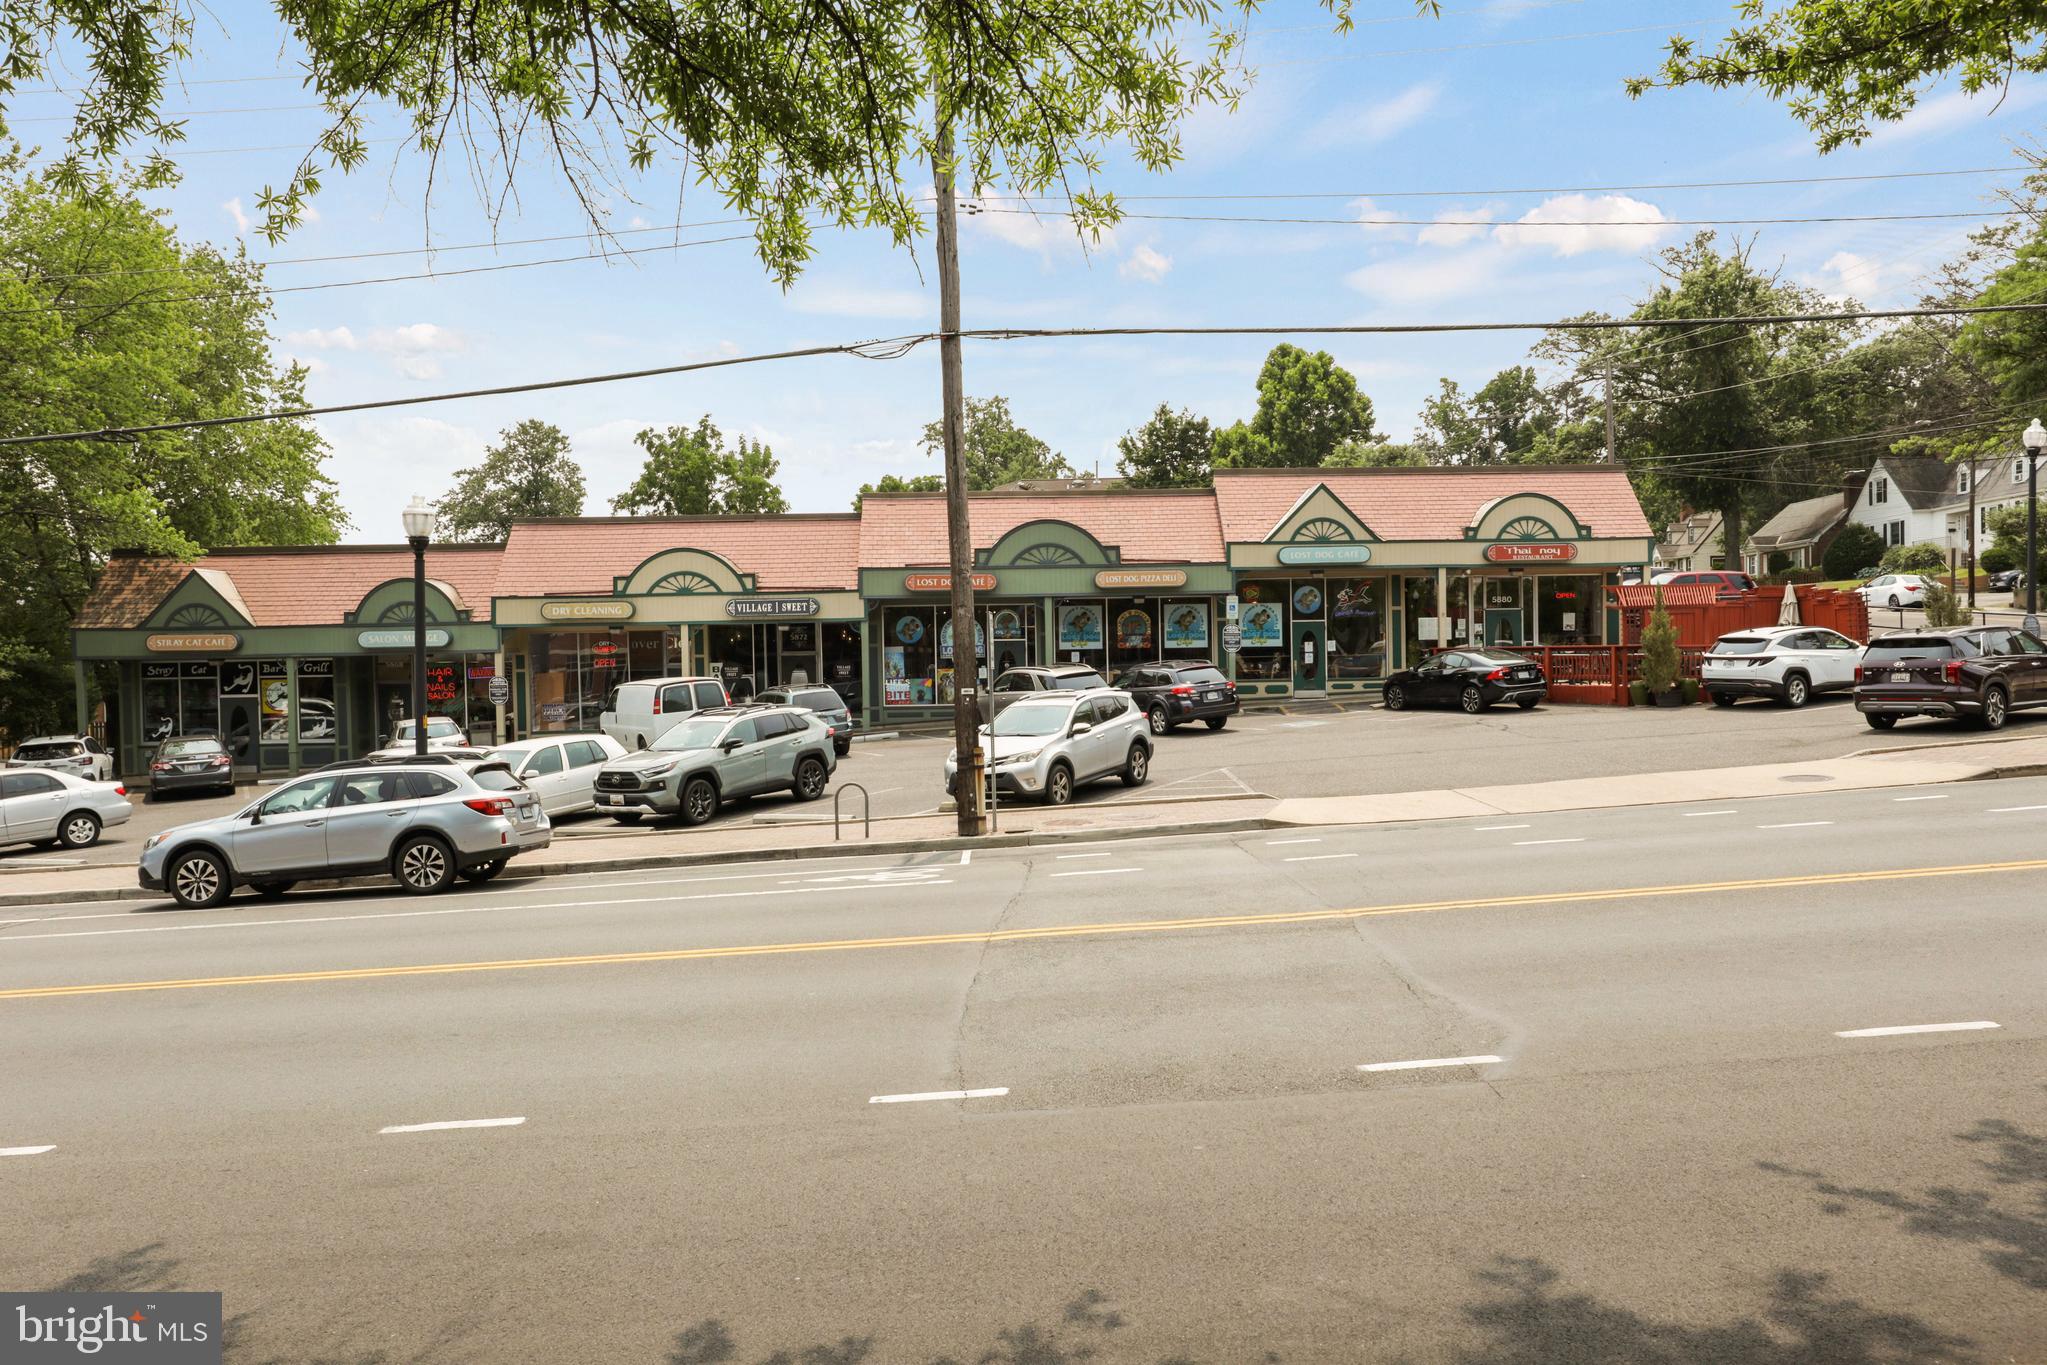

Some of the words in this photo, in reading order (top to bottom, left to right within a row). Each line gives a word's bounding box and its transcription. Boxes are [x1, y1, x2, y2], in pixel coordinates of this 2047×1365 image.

[1290, 551, 1311, 560] LOST
[1314, 551, 1334, 559] DOG
[1503, 546, 1531, 555] Thai
[1539, 548, 1560, 556] noy
[916, 578, 938, 586] LOST
[940, 578, 952, 586] DO
[1105, 575, 1121, 583] LOST
[1123, 575, 1138, 583] DOG
[1140, 575, 1161, 583] PIZZA
[1162, 574, 1177, 582] DELI
[1491, 595, 1513, 604] 5880
[552, 606, 572, 616] DRY
[574, 605, 622, 615] CLEANING
[737, 602, 773, 613] VILLAGE
[781, 602, 808, 612] SWEET
[156, 639, 183, 648] STRAY
[185, 638, 203, 647] CAT
[367, 634, 399, 644] SALON
[594, 658, 616, 668] OPEN
[147, 666, 174, 677] Stray
[191, 665, 207, 674] Cat
[262, 664, 281, 673] Bar
[303, 662, 330, 672] Grill
[427, 667, 454, 677] HAIR
[437, 675, 443, 683] &
[426, 682, 456, 692] NAILS
[427, 691, 456, 700] SALON
